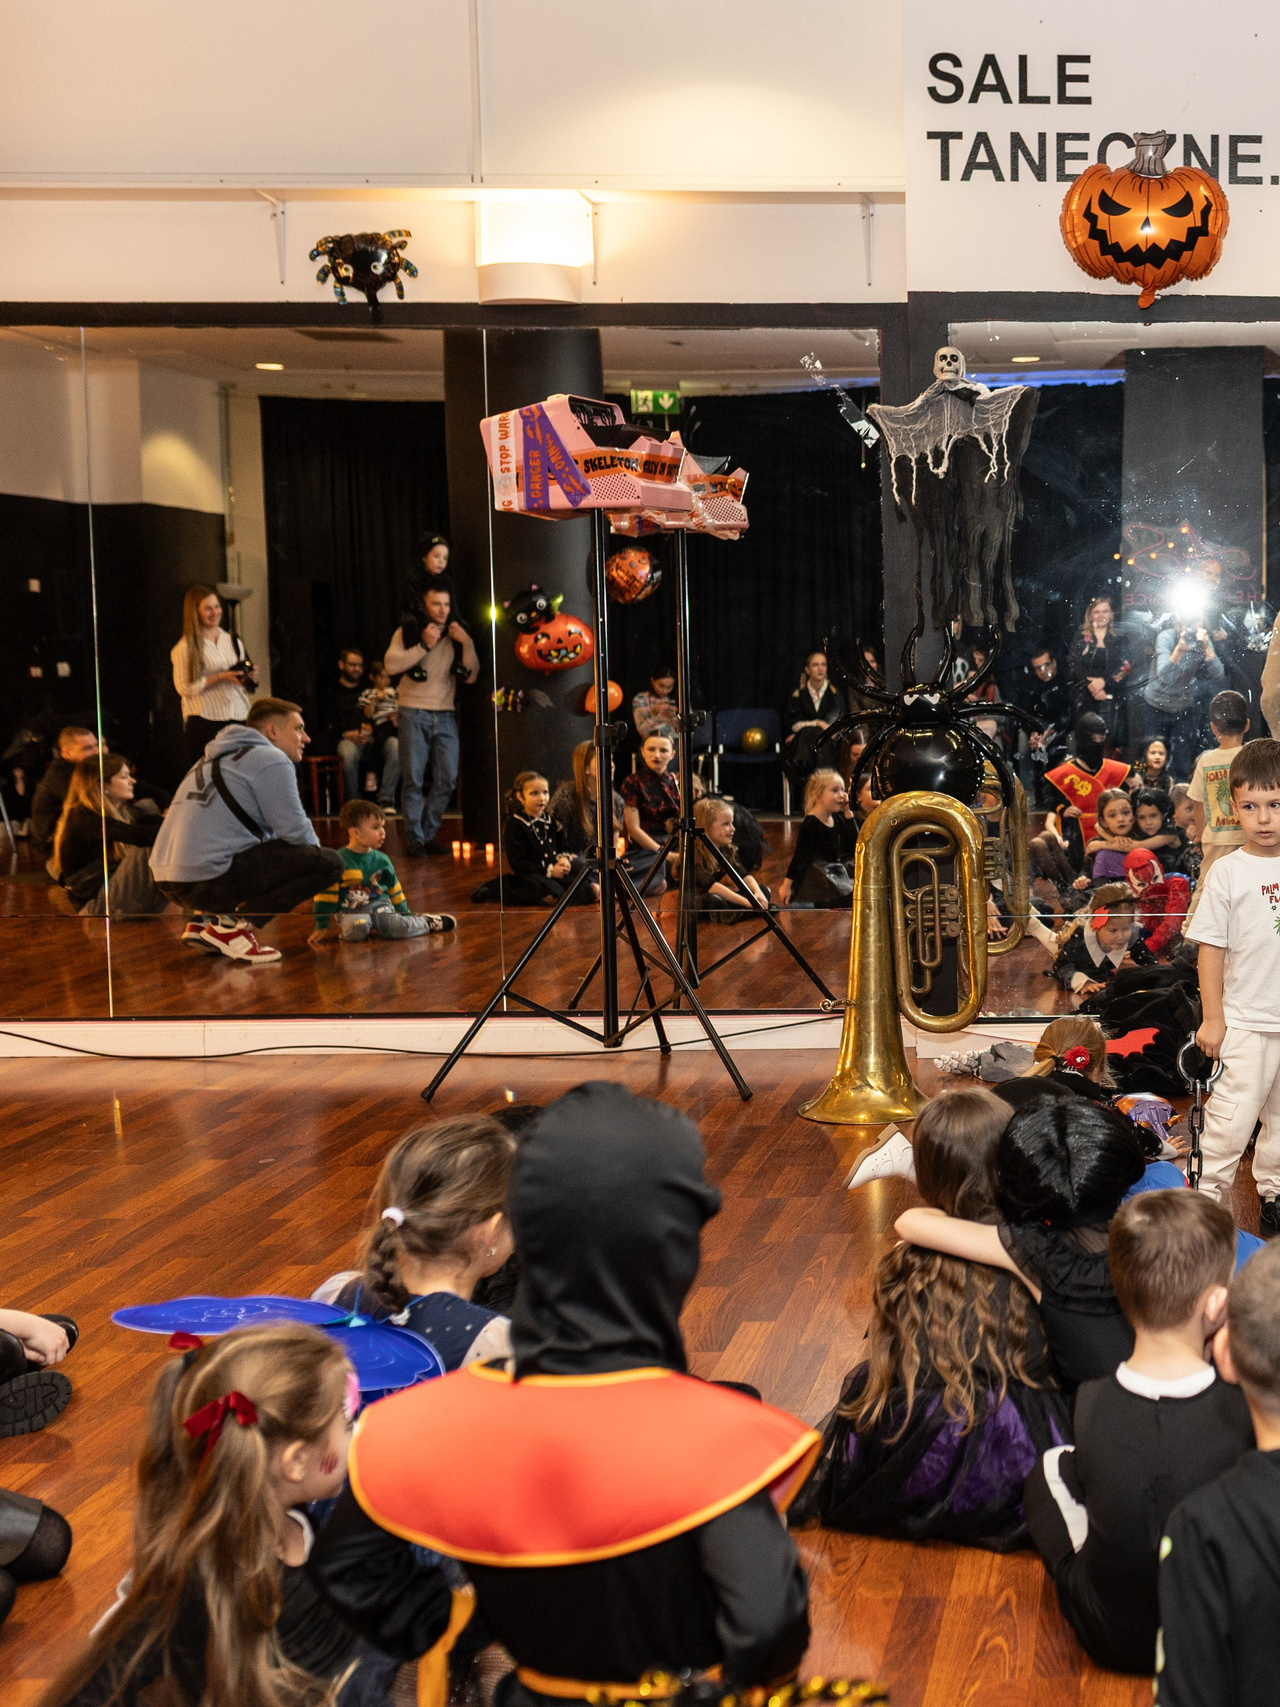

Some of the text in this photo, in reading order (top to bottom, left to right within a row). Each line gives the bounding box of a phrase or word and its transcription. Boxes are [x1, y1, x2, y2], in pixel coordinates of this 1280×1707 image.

[926, 51, 1092, 105] SALE
[499, 445, 513, 474] STOP
[528, 449, 544, 499] DANGER
[583, 455, 639, 475] SKELETON
[1261, 883, 1280, 896] PALM
